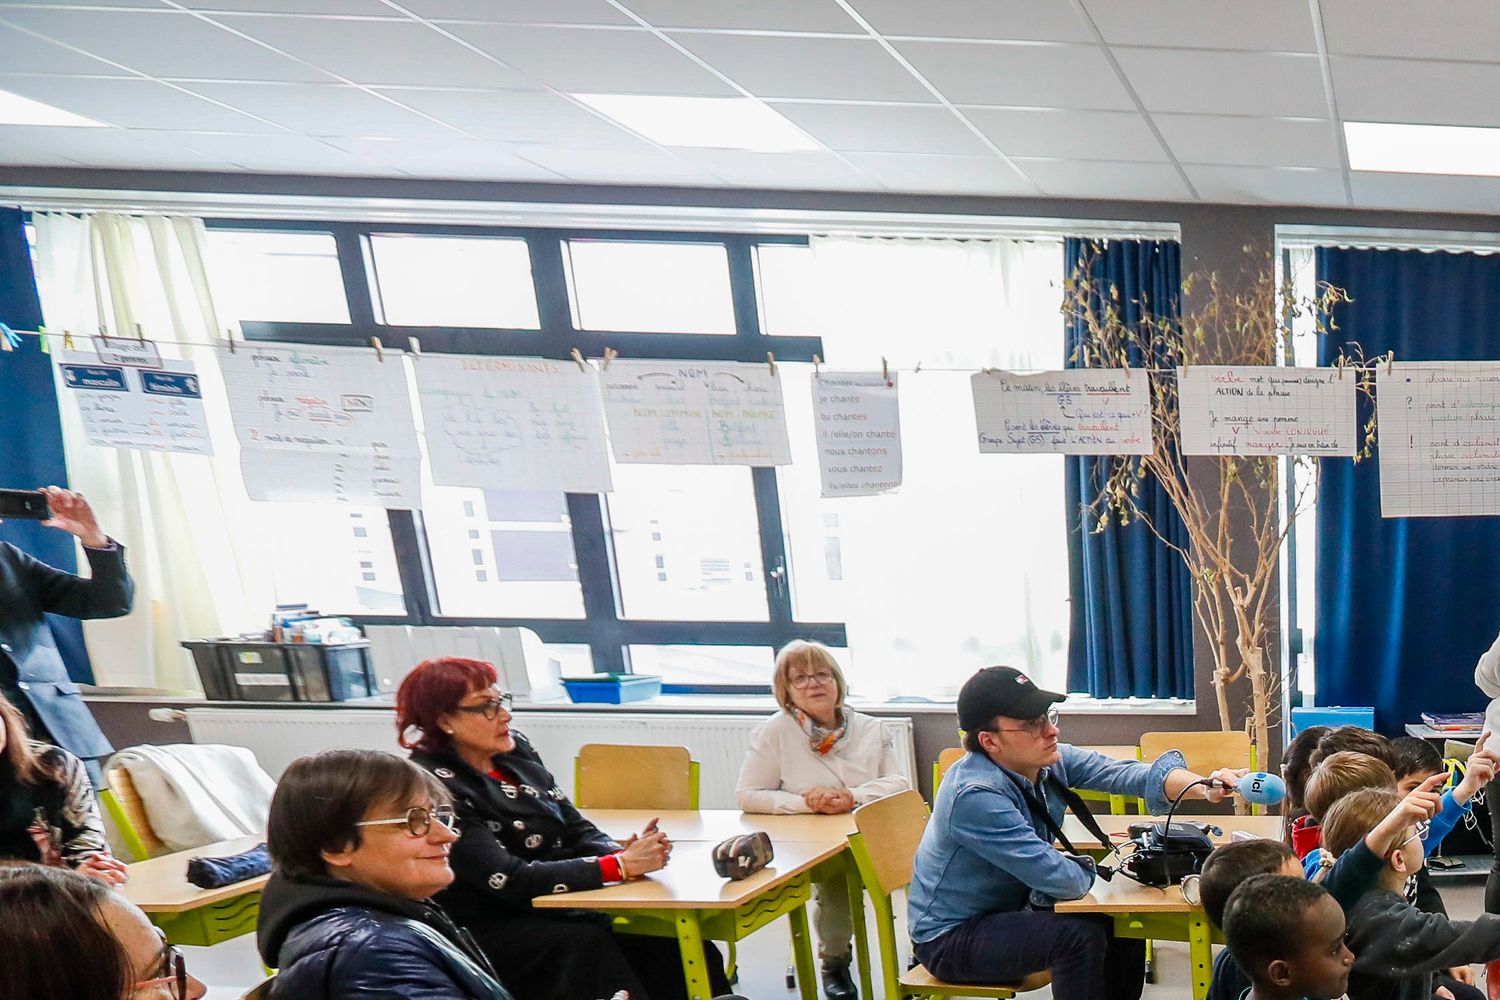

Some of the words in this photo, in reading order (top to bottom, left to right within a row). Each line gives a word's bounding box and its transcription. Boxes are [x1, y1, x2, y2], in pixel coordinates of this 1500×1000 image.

[1085, 379, 1131, 394] travaillent
[1215, 387, 1244, 397] ACTION
[830, 395, 861, 403] chante
[1406, 396, 1413, 409] ?
[833, 413, 868, 421] chantes
[1224, 415, 1255, 428] mange
[865, 430, 897, 438] chante
[824, 448, 846, 456] nous
[847, 447, 888, 456] chantons
[849, 465, 883, 473] chantez
